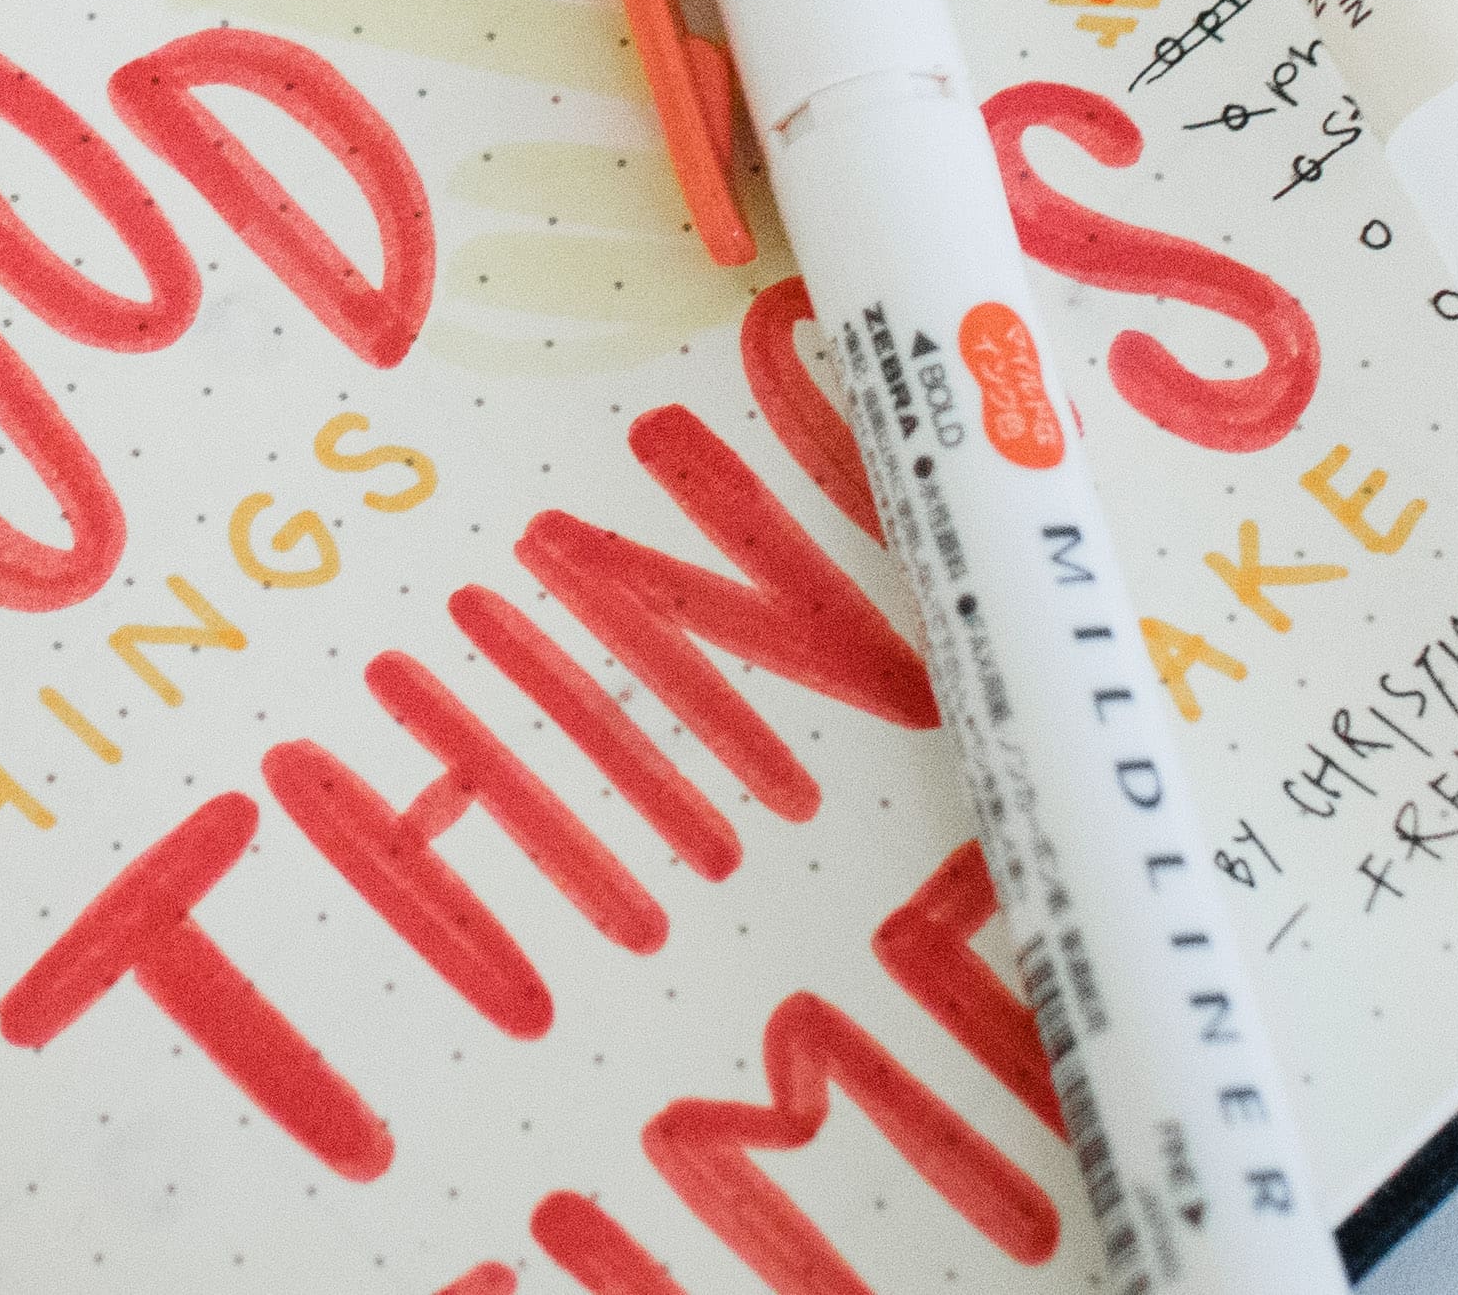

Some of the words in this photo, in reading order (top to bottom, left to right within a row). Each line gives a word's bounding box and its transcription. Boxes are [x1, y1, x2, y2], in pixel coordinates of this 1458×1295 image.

[862, 299, 921, 441] ZEBRA
[918, 363, 966, 450] BOLD
[1138, 439, 1426, 724] AKE
[1041, 521, 1296, 1216] MILDLINER
[1213, 818, 1283, 890] BY
